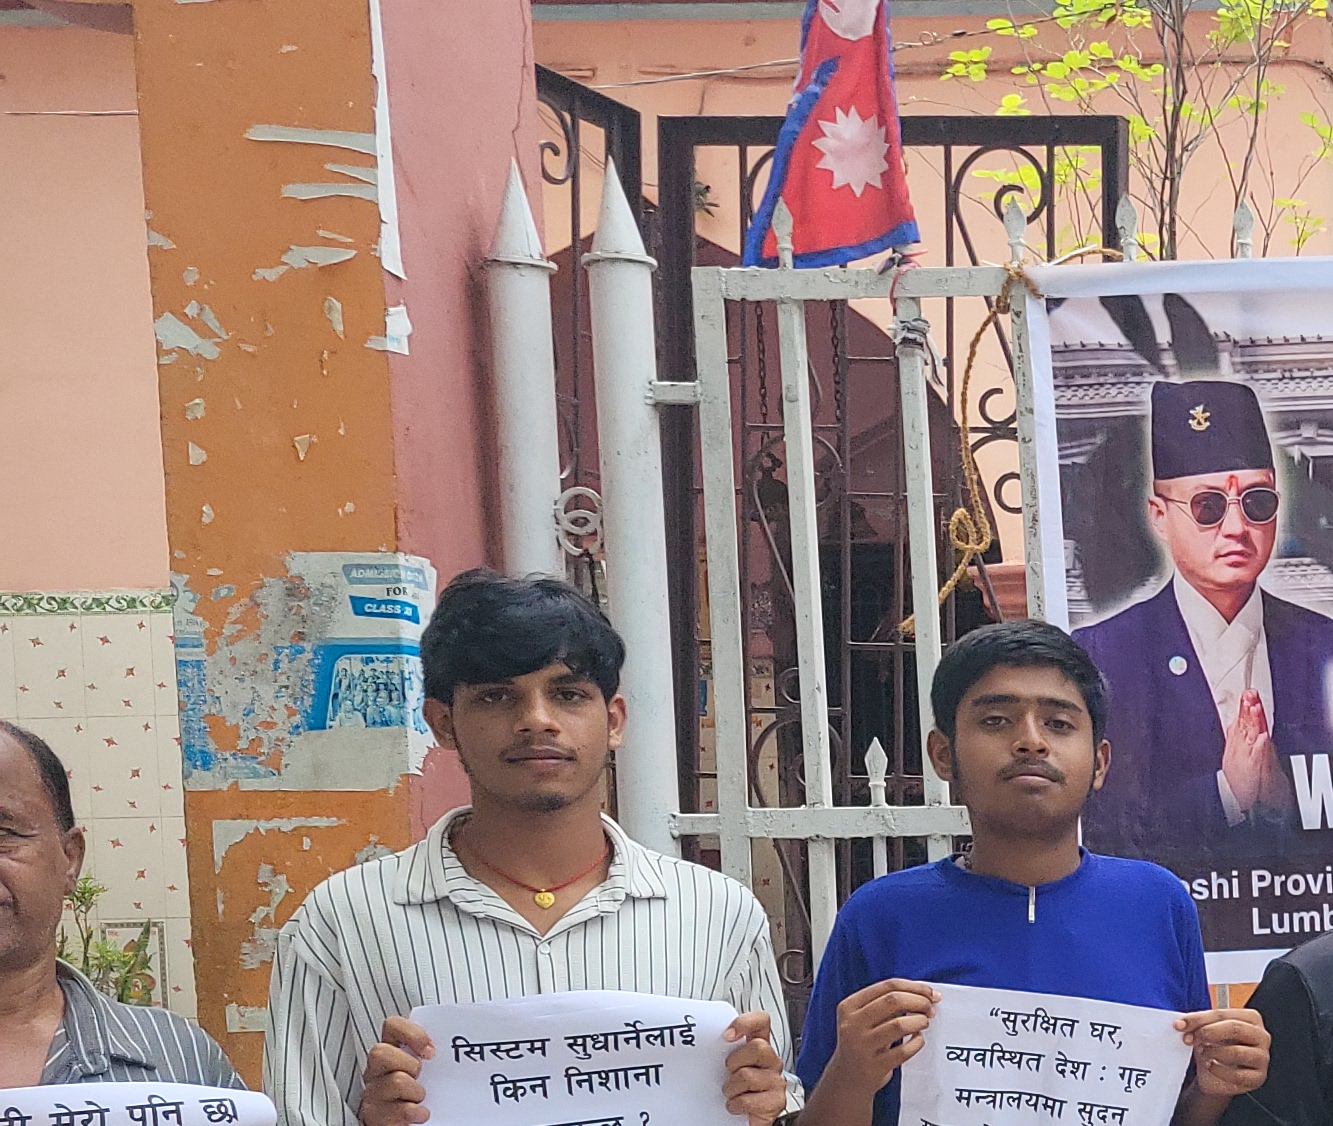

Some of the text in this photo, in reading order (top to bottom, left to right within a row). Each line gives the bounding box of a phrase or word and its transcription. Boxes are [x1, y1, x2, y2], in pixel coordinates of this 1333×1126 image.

[364, 603, 402, 614] CLASS
[451, 1014, 697, 1063] सिस्टम सुधार्नेलाई
[1089, 1021, 1124, 1050] घर,
[489, 1063, 664, 1105] किन निशाना
[945, 1042, 1045, 1073] व्यवस्थित
[1054, 1052, 1092, 1082] देश
[1117, 1064, 1151, 1094] गृह
[954, 1086, 1068, 1119] मन्त्रालयमा
